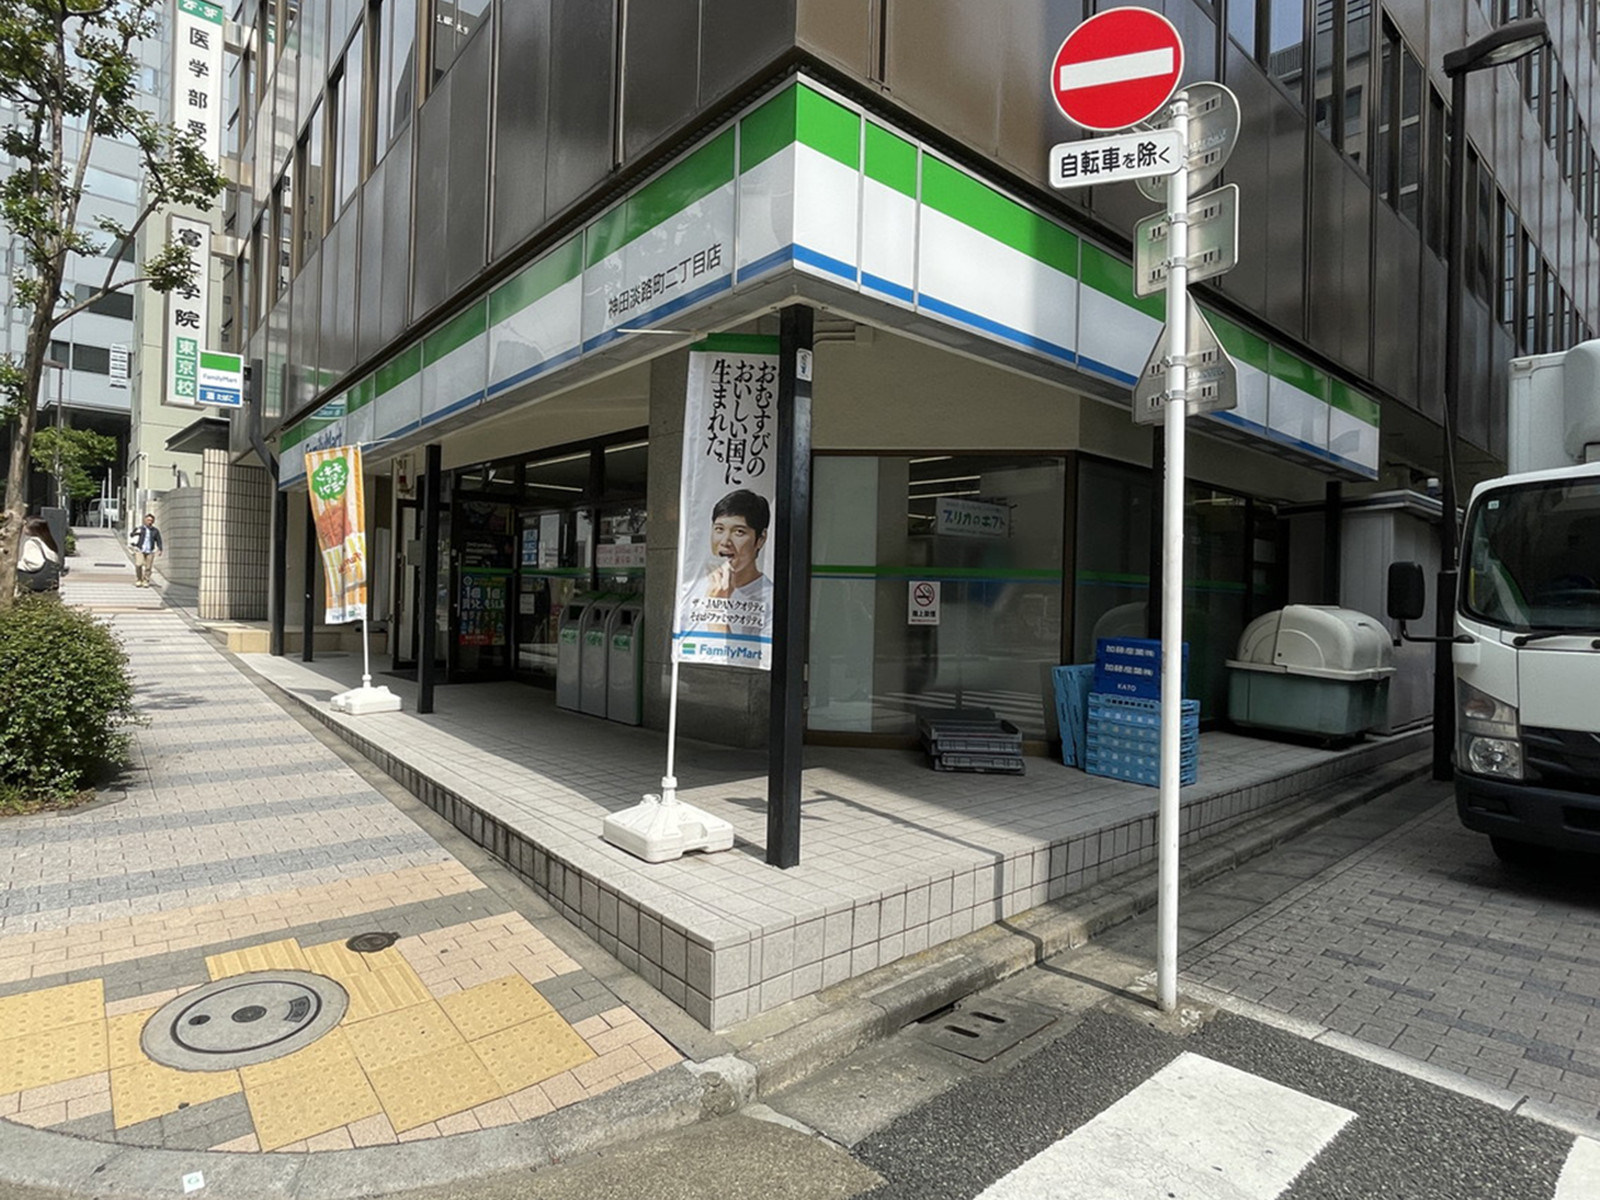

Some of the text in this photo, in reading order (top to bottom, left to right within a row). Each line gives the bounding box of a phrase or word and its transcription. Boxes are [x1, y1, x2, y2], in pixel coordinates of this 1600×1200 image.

[1060, 141, 1170, 178] 自転車を除く
[608, 243, 722, 319] 神田淡路町二丁目店
[177, 338, 196, 397] 東京校
[203, 373, 238, 384] FamilyMart
[707, 358, 732, 463] 生まれた。
[725, 359, 755, 485] おいしい国に
[746, 360, 777, 478] おむすびの
[699, 643, 762, 660] FamilyMart
[1117, 682, 1137, 692] KATO
